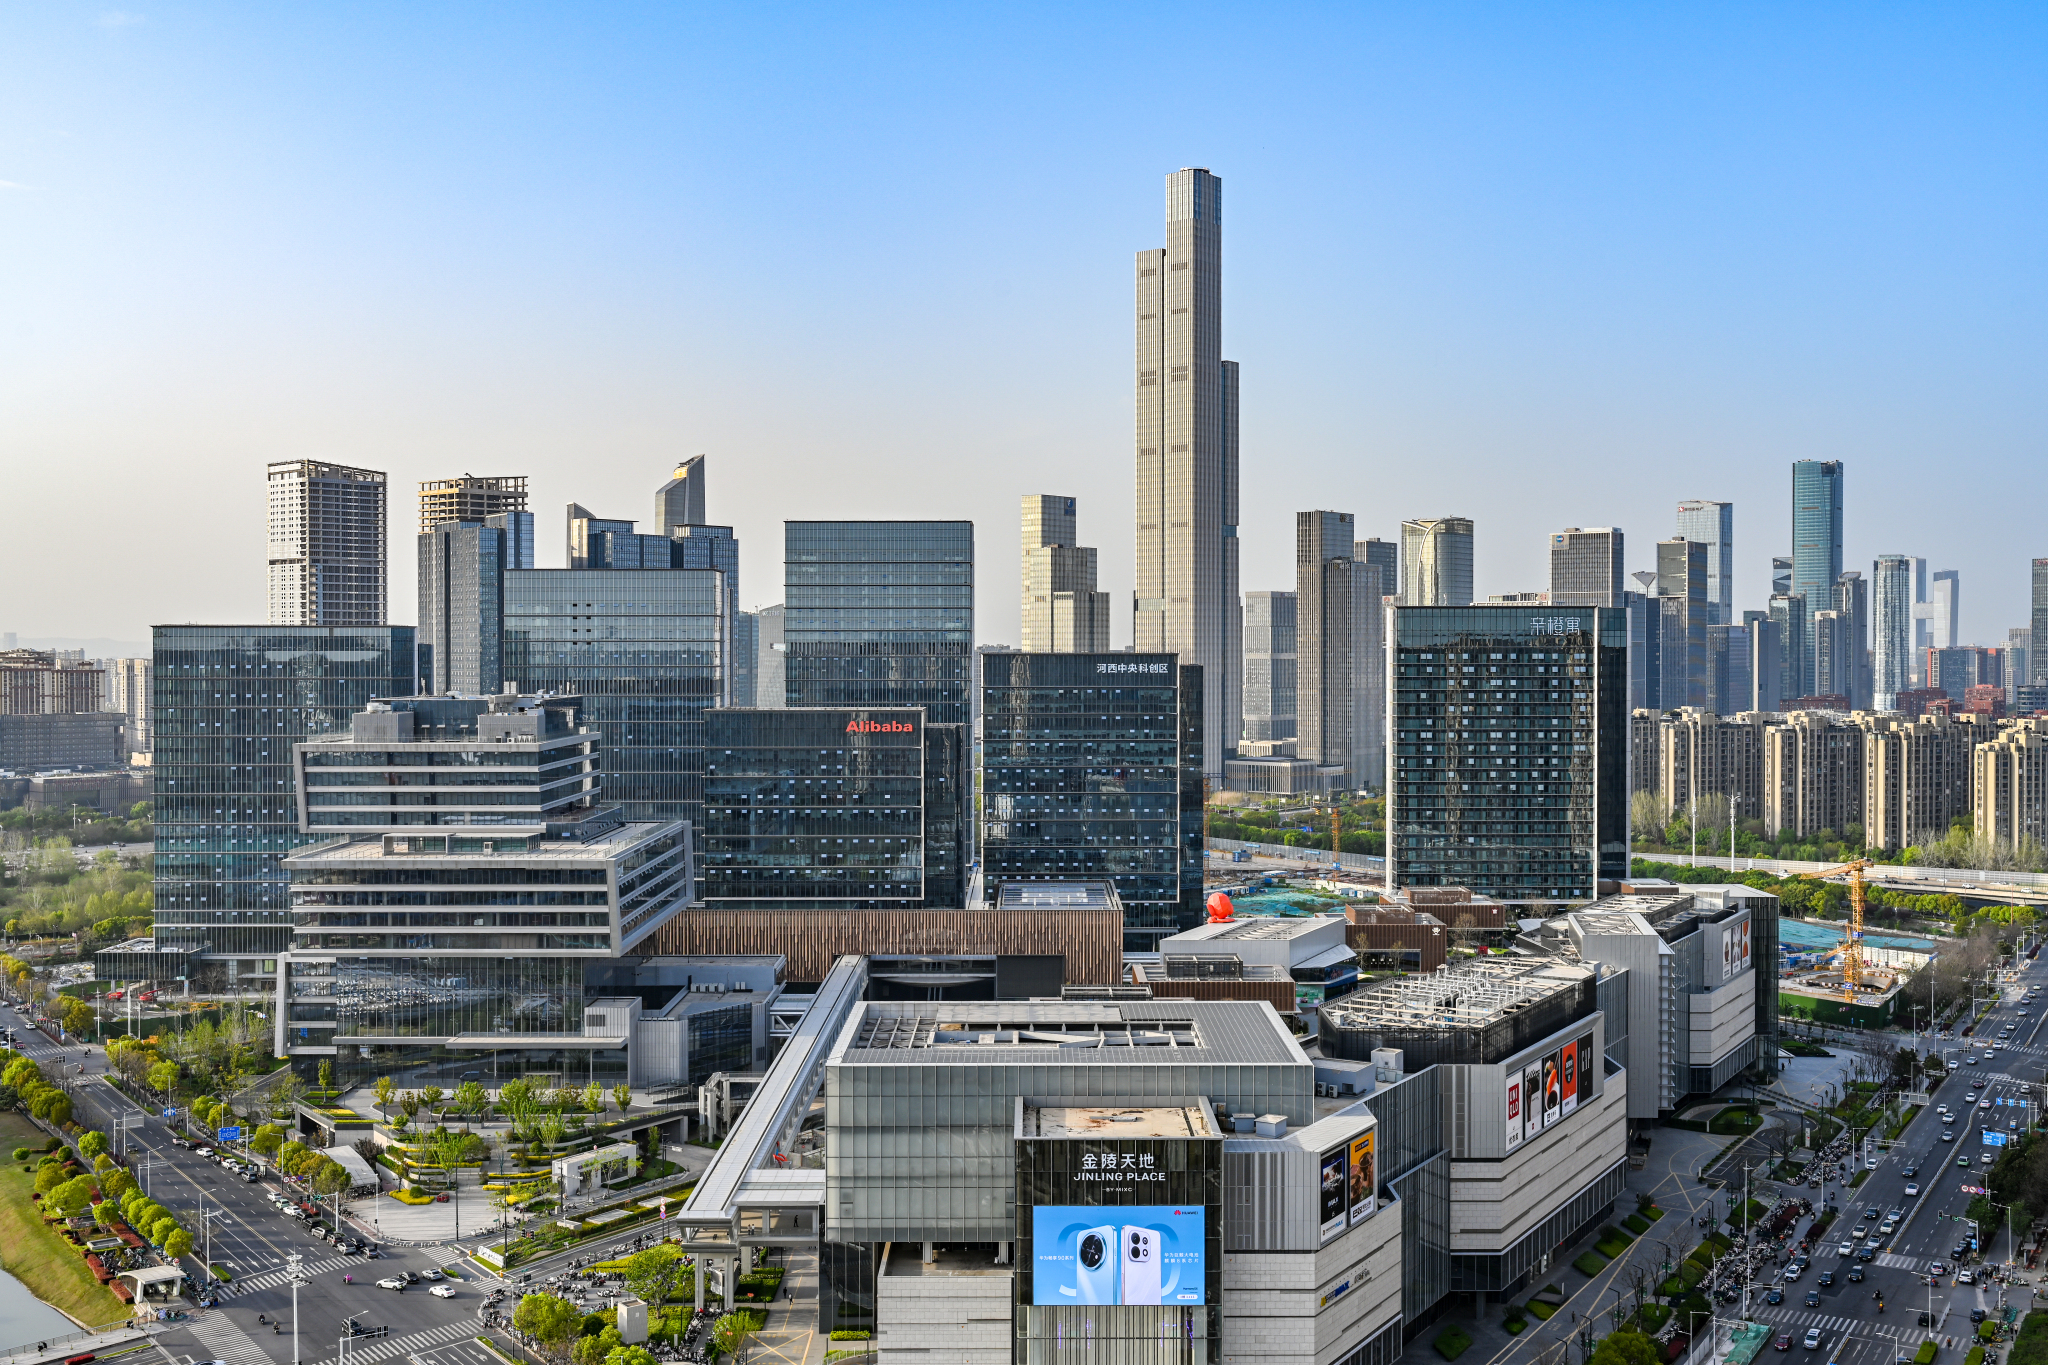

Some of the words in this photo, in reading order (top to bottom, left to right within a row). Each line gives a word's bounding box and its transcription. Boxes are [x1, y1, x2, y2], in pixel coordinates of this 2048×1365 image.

[1530, 616, 1581, 636] 亲橙寓
[1096, 662, 1169, 674] 河西中央科创区
[845, 720, 913, 733] Alibaba
[1581, 1046, 1591, 1073] GAP
[1509, 1087, 1518, 1102] UNI
[1509, 1101, 1519, 1117] QLO
[1081, 1152, 1155, 1170] 金陵天地
[1073, 1172, 1123, 1181] JINLING
[1126, 1172, 1166, 1181] PLACE
